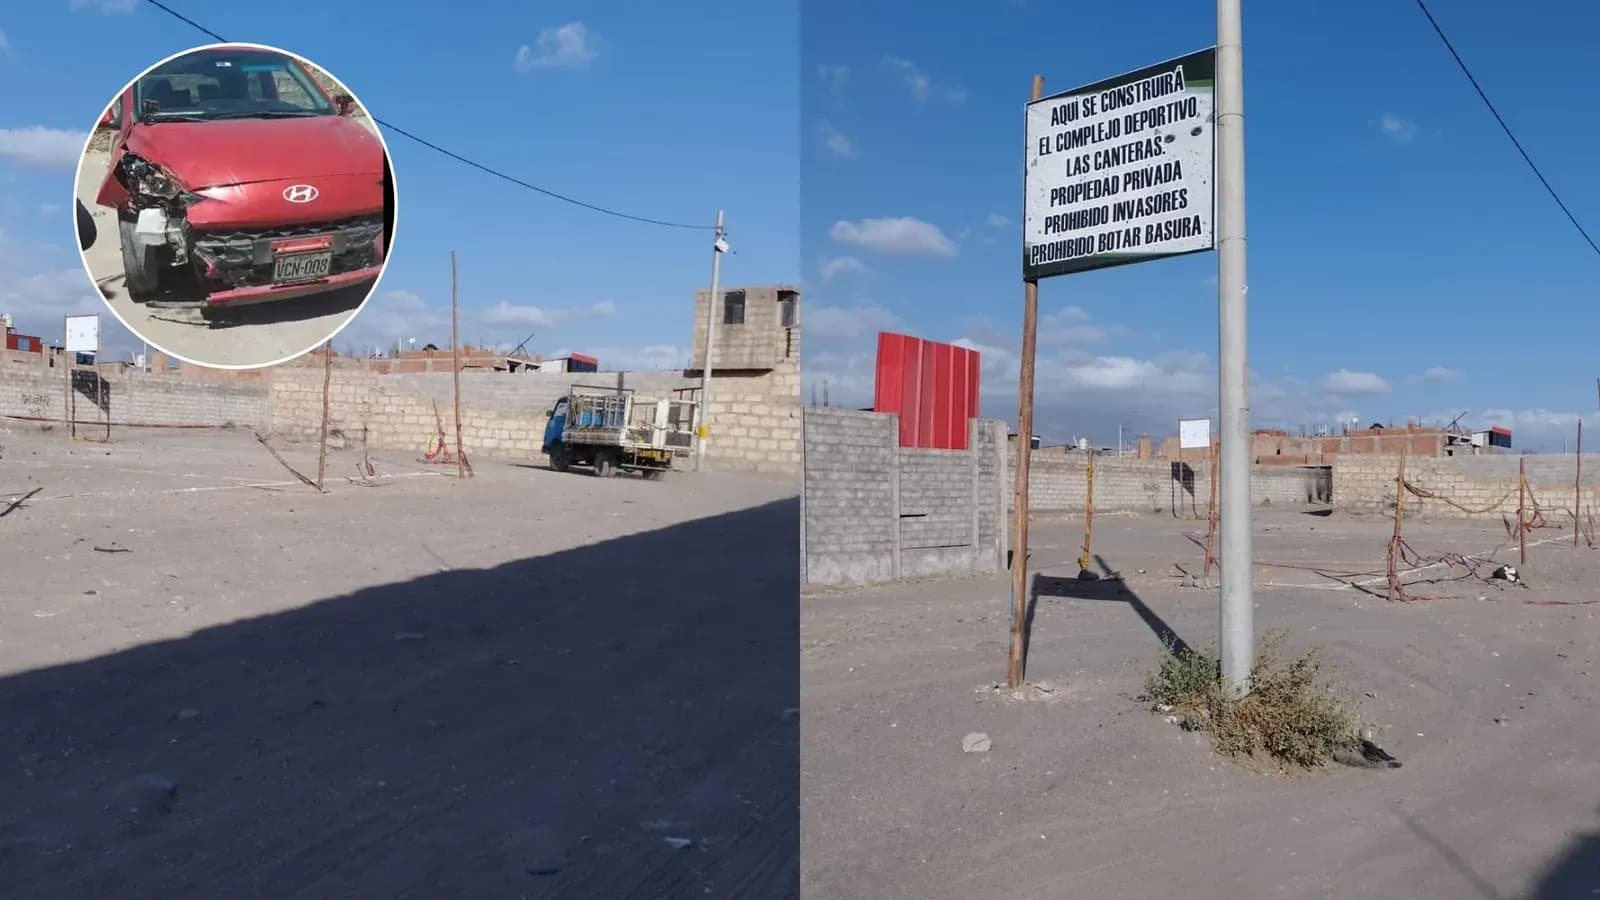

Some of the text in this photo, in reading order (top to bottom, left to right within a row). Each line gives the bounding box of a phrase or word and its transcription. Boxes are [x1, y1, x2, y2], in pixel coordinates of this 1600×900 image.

[1082, 93, 1097, 117] SE
[1101, 65, 1184, 113] CONSTRUIRÁ
[1039, 136, 1052, 156] EL
[1056, 120, 1121, 151] COMPLEJO
[1066, 136, 1166, 177] LAS CANTERAS.
[1050, 160, 1182, 207] PROPIEDAD PRIVADA
[1044, 188, 1187, 235] PROHIBIDO INVASORES
[1031, 215, 1201, 264] PROHIBIDO BOTAR BASURA
